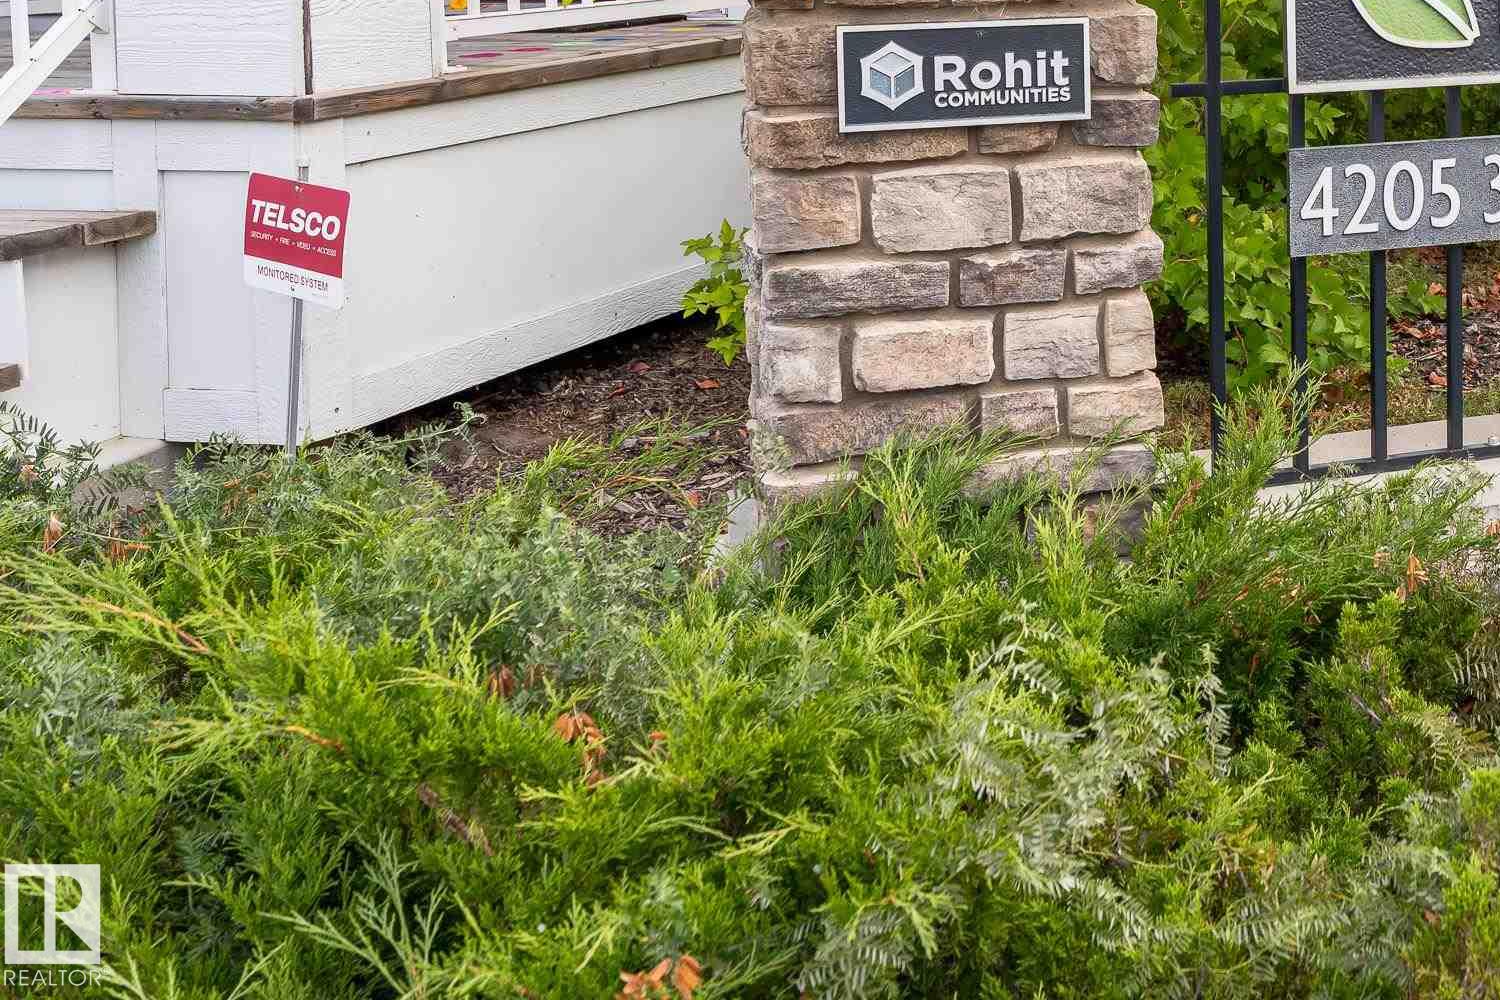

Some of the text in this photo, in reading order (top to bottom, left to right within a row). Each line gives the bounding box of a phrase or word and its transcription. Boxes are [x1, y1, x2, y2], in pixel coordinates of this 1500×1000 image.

[932, 50, 1070, 92] Rohit
[934, 86, 1072, 109] COMMUNITIES
[1300, 157, 1462, 237] 4205
[252, 199, 341, 241] TELSCO
[257, 265, 329, 292] MONITORED SYSTEM
